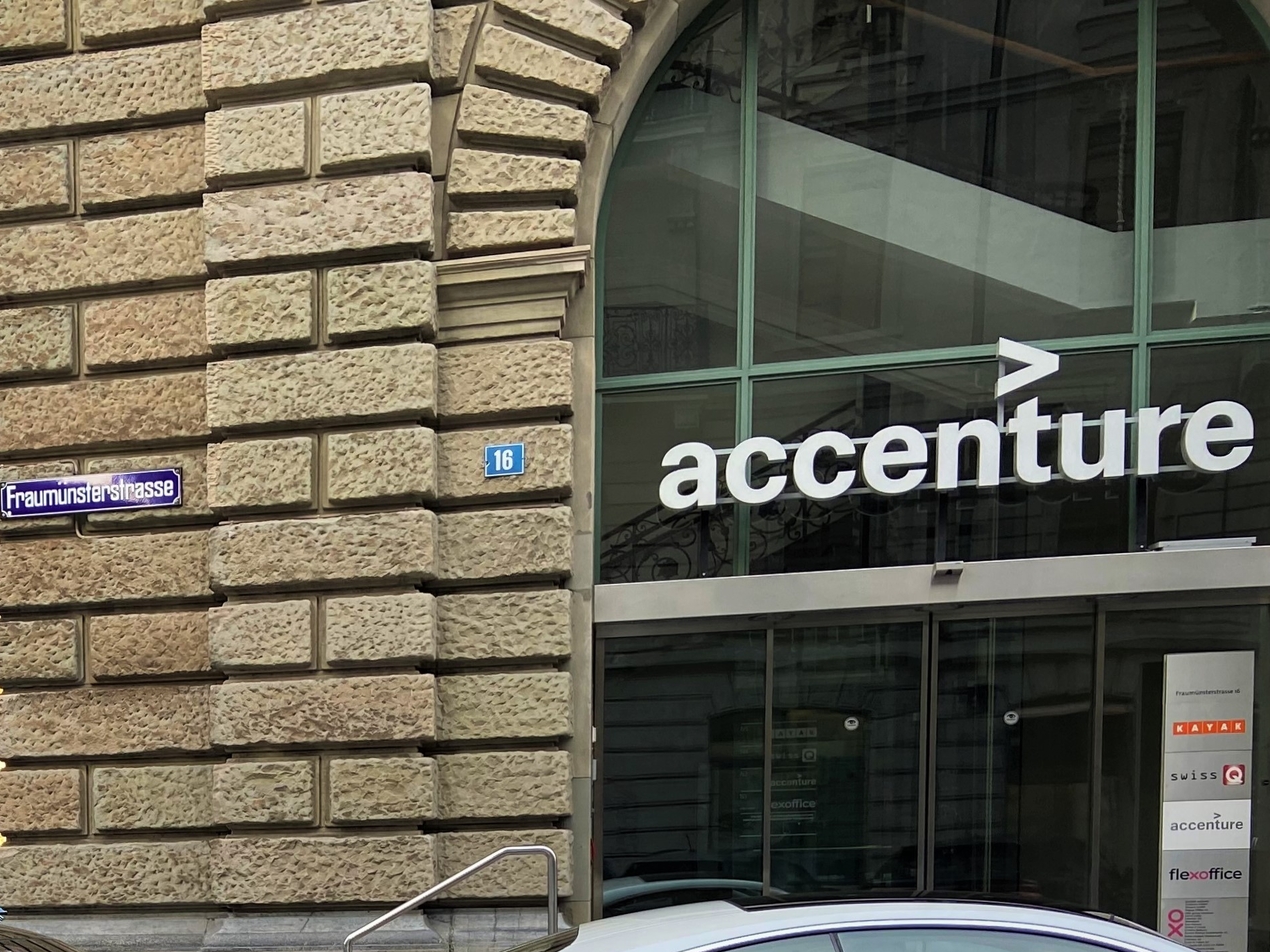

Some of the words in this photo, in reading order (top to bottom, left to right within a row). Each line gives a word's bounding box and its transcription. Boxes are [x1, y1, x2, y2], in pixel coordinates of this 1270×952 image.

[494, 449, 514, 471] 16
[658, 396, 1255, 512] accenture
[6, 479, 174, 510] Fraumünsterstrasse
[1176, 722, 1242, 734] KAYAK
[1170, 770, 1218, 782] swiss
[1225, 765, 1244, 785] Q
[1170, 819, 1244, 831] accenture
[1169, 867, 1242, 881] flexoffice
